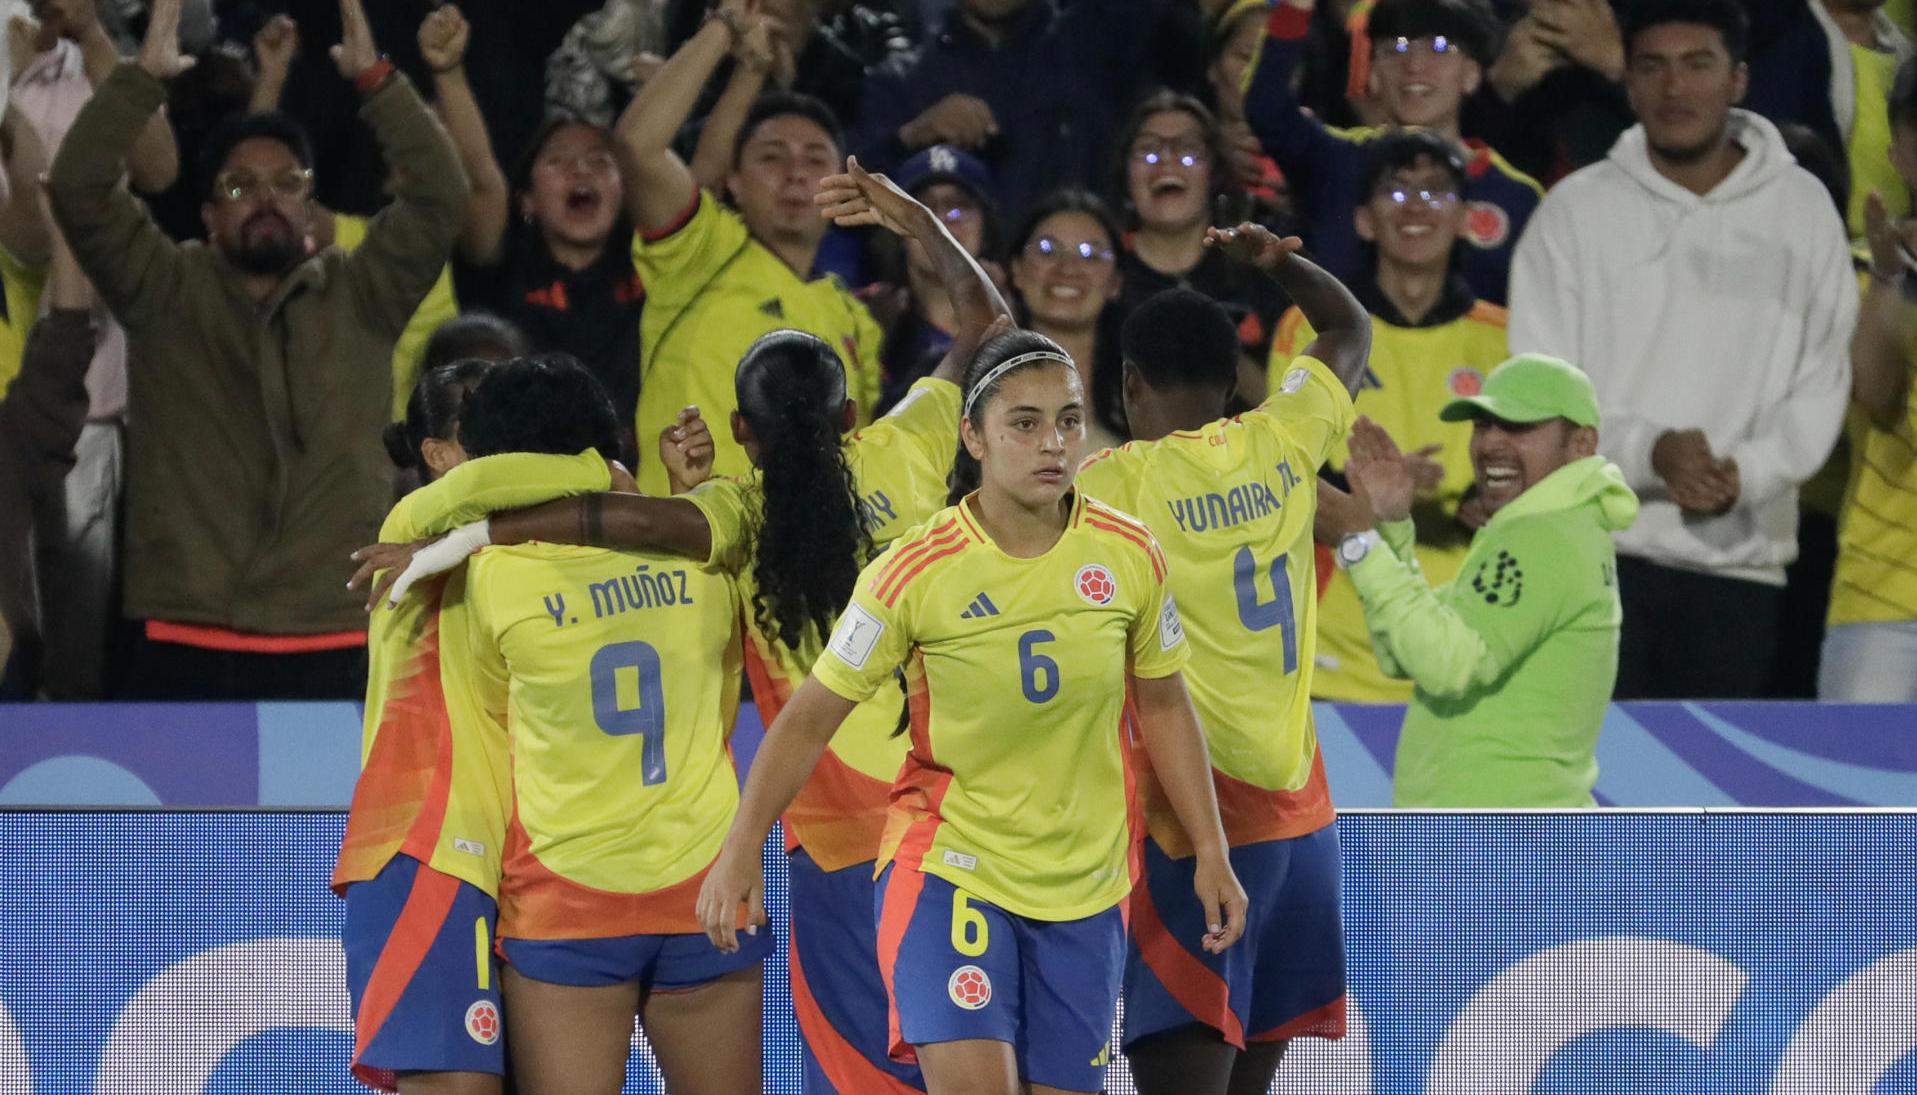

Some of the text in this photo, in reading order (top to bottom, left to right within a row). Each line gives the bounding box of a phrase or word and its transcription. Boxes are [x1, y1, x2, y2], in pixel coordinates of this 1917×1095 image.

[1168, 482, 1281, 532] YUNAIRA
[544, 565, 693, 627] Y. MUÑOZ
[1234, 544, 1297, 676] 4
[1018, 629, 1060, 704] 6
[590, 640, 667, 786] 9
[951, 886, 989, 957] 6
